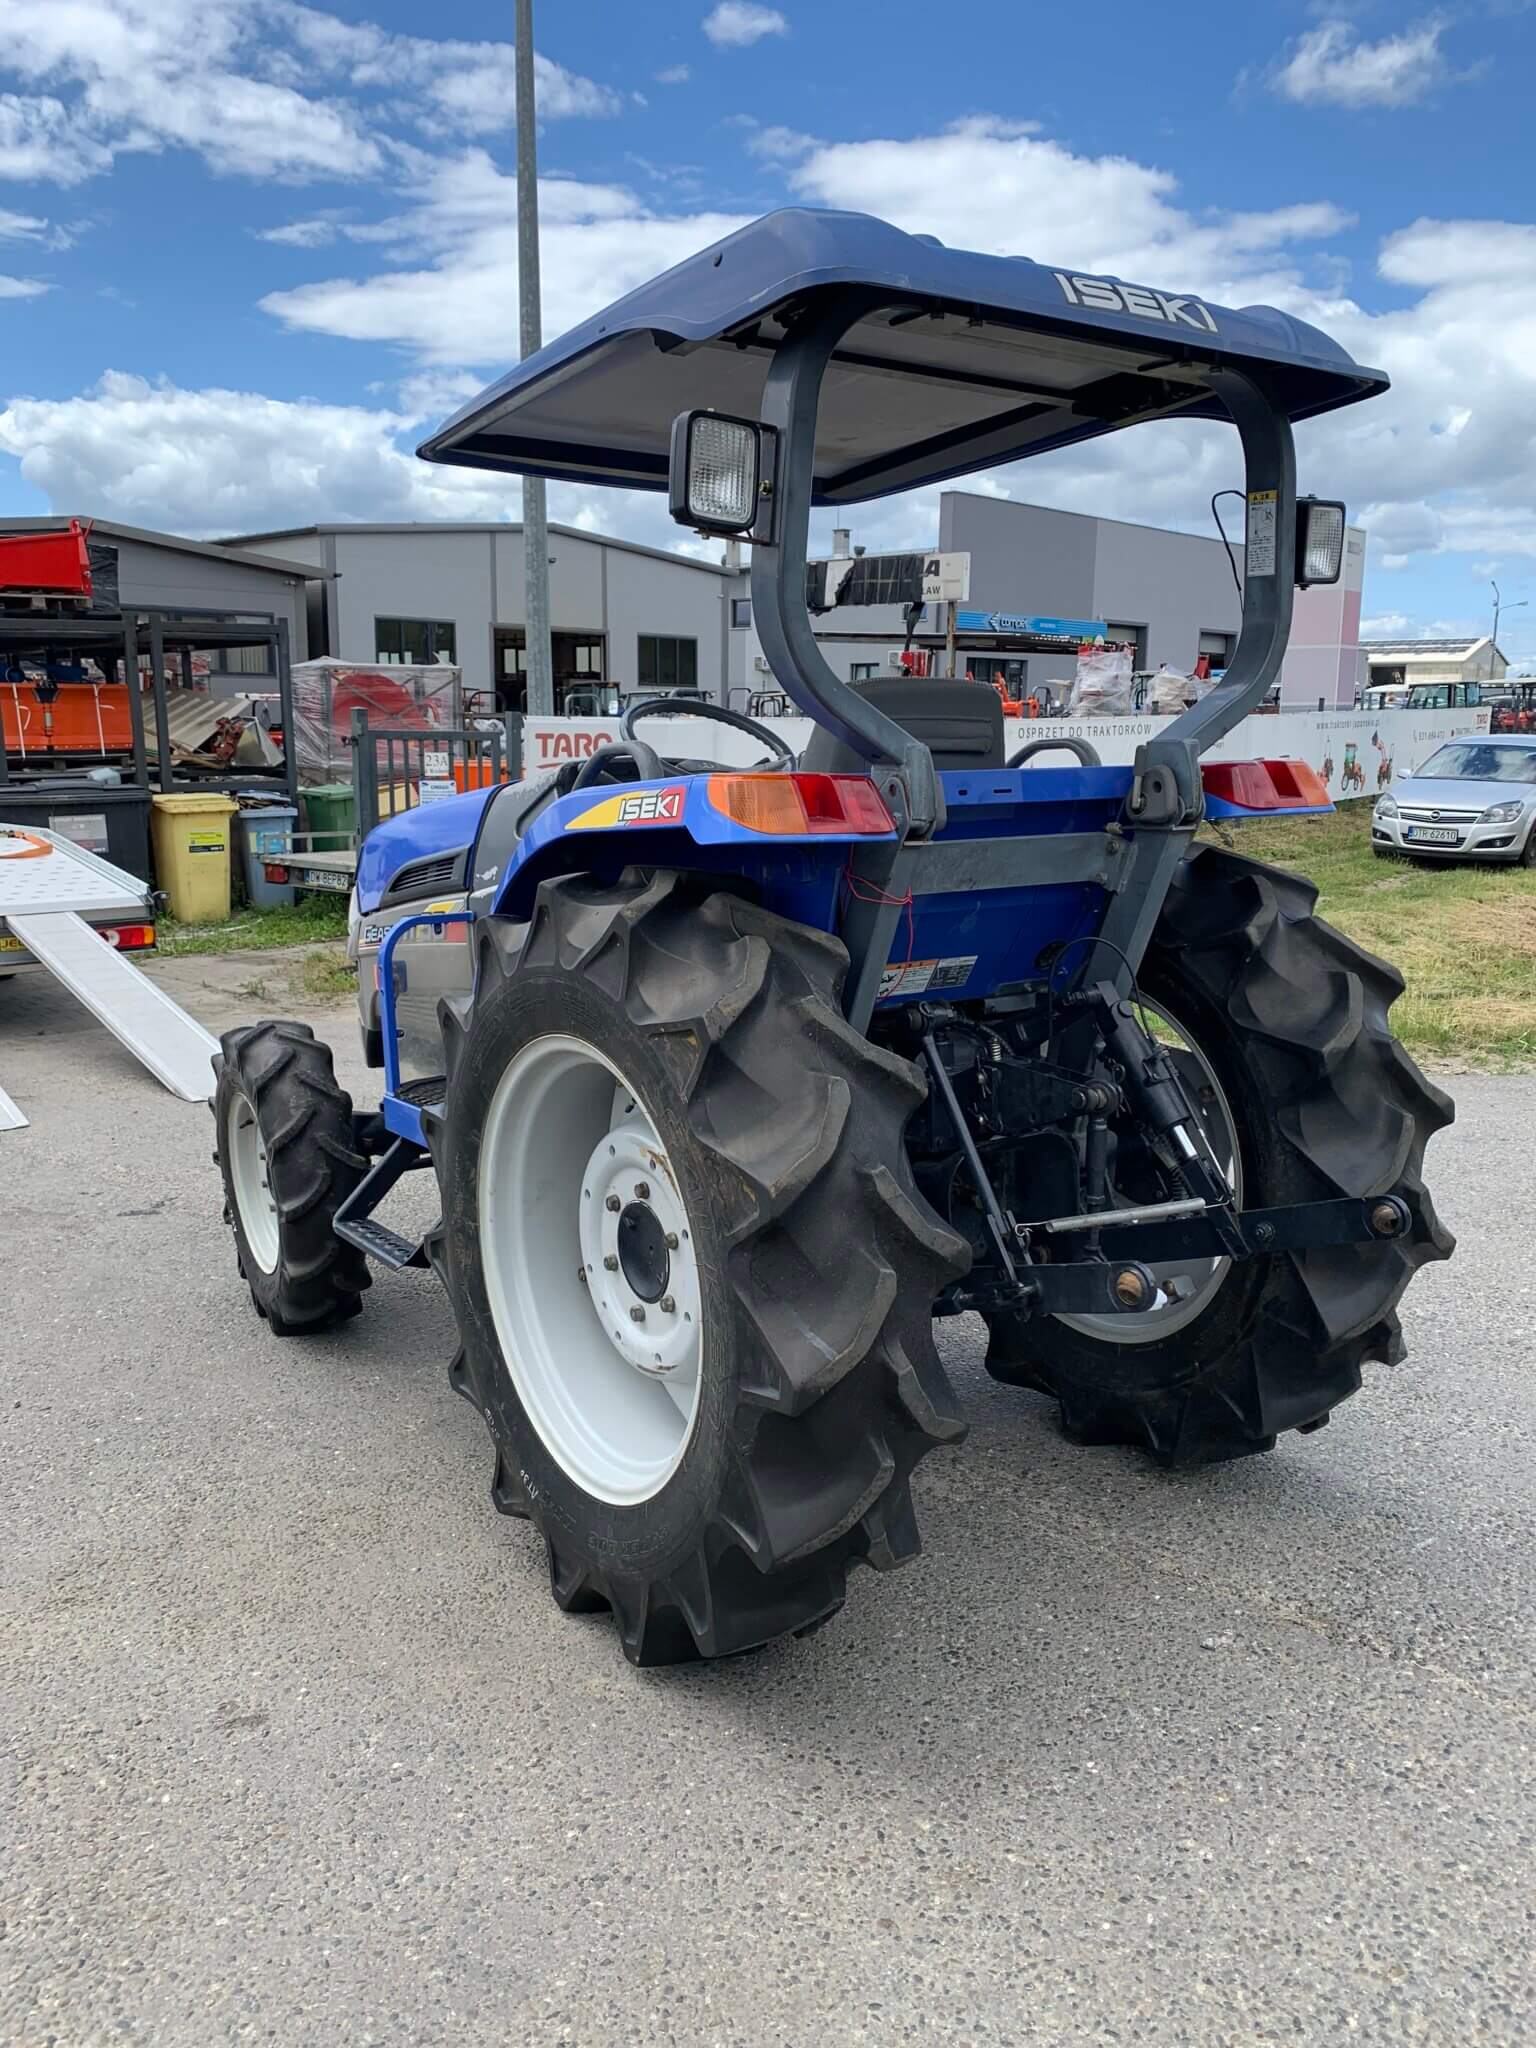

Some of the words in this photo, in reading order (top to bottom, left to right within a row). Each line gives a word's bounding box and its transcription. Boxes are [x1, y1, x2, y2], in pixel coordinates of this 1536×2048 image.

[1053, 272, 1218, 333] ISEKI
[1068, 726, 1083, 738] DO
[425, 754, 448, 767] 23A
[618, 793, 681, 822] ISEKI
[1430, 830, 1457, 840] 62610
